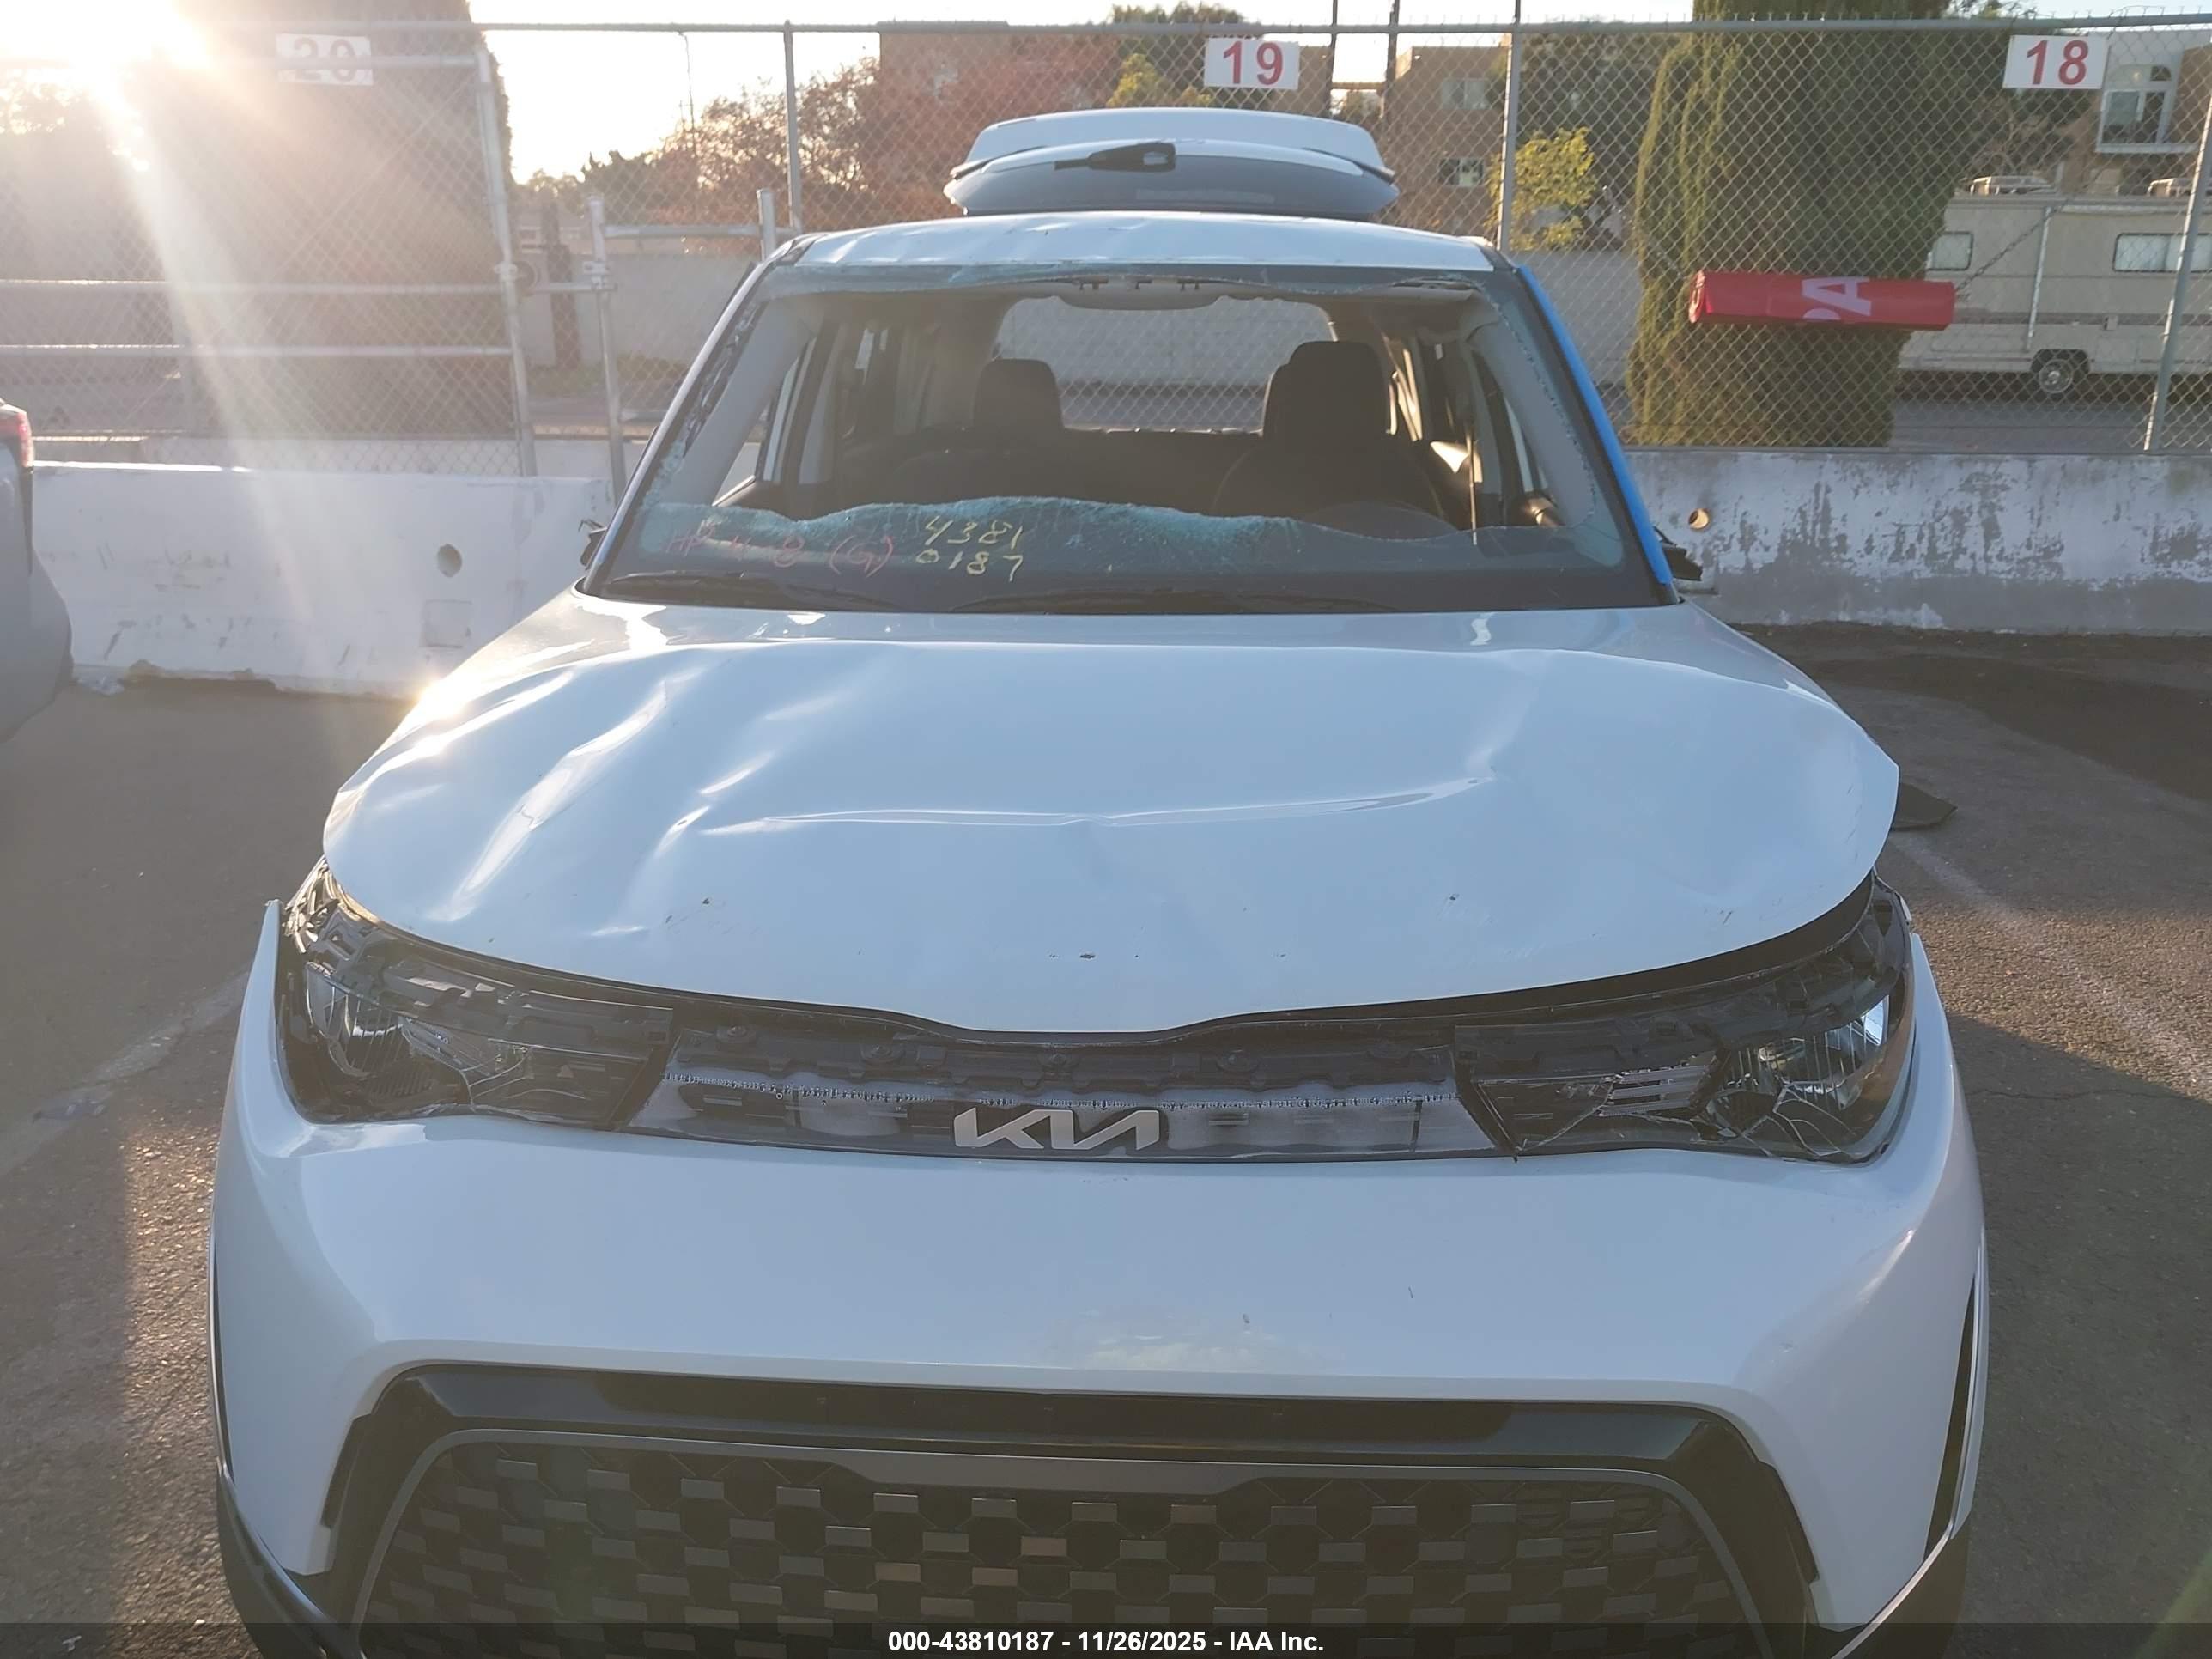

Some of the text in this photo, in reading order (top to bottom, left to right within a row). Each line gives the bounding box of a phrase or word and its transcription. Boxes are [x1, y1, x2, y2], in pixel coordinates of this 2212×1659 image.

[293, 36, 358, 82] 20
[1223, 40, 1283, 85] 19
[2027, 40, 2088, 85] 18
[925, 515, 1023, 550] 4381
[915, 549, 1024, 582] 0187
[954, 1107, 1159, 1151] KIA
